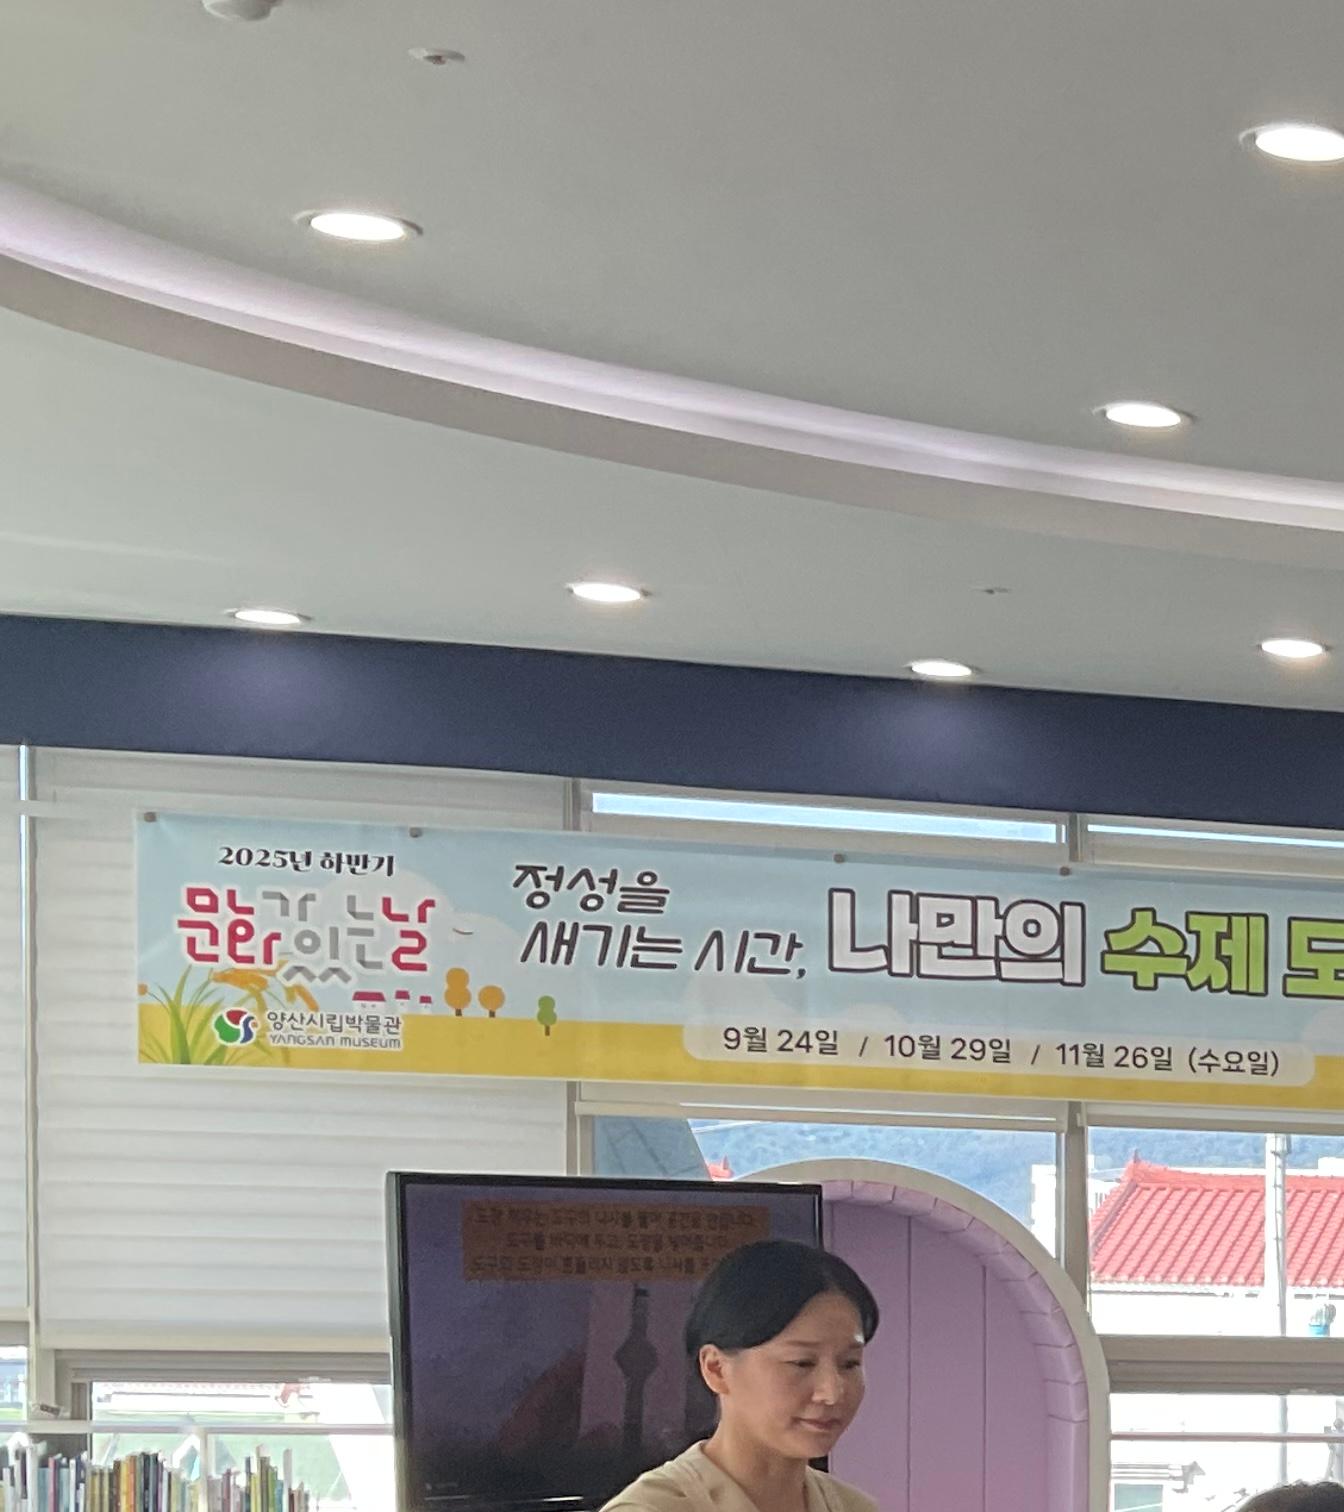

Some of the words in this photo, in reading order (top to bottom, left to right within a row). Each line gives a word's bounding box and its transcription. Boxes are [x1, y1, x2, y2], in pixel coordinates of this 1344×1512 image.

[218, 846, 312, 874] 2025년
[319, 851, 395, 877] 하반기
[512, 865, 670, 914] 정성을
[381, 896, 437, 972] 날
[520, 921, 684, 970] 새기는
[694, 929, 807, 980] 시간,
[828, 887, 1086, 988] 나만의
[1101, 907, 1269, 997] 수제
[267, 1011, 403, 1036] 양산시립박물관
[723, 1026, 768, 1053] 9월
[777, 1029, 839, 1056] 24일
[884, 1034, 941, 1061] 10월
[951, 1037, 1011, 1064] 29일
[1056, 1042, 1105, 1069] 11월
[1114, 1045, 1173, 1072] 26일
[1188, 1046, 1280, 1077] (수요일)
